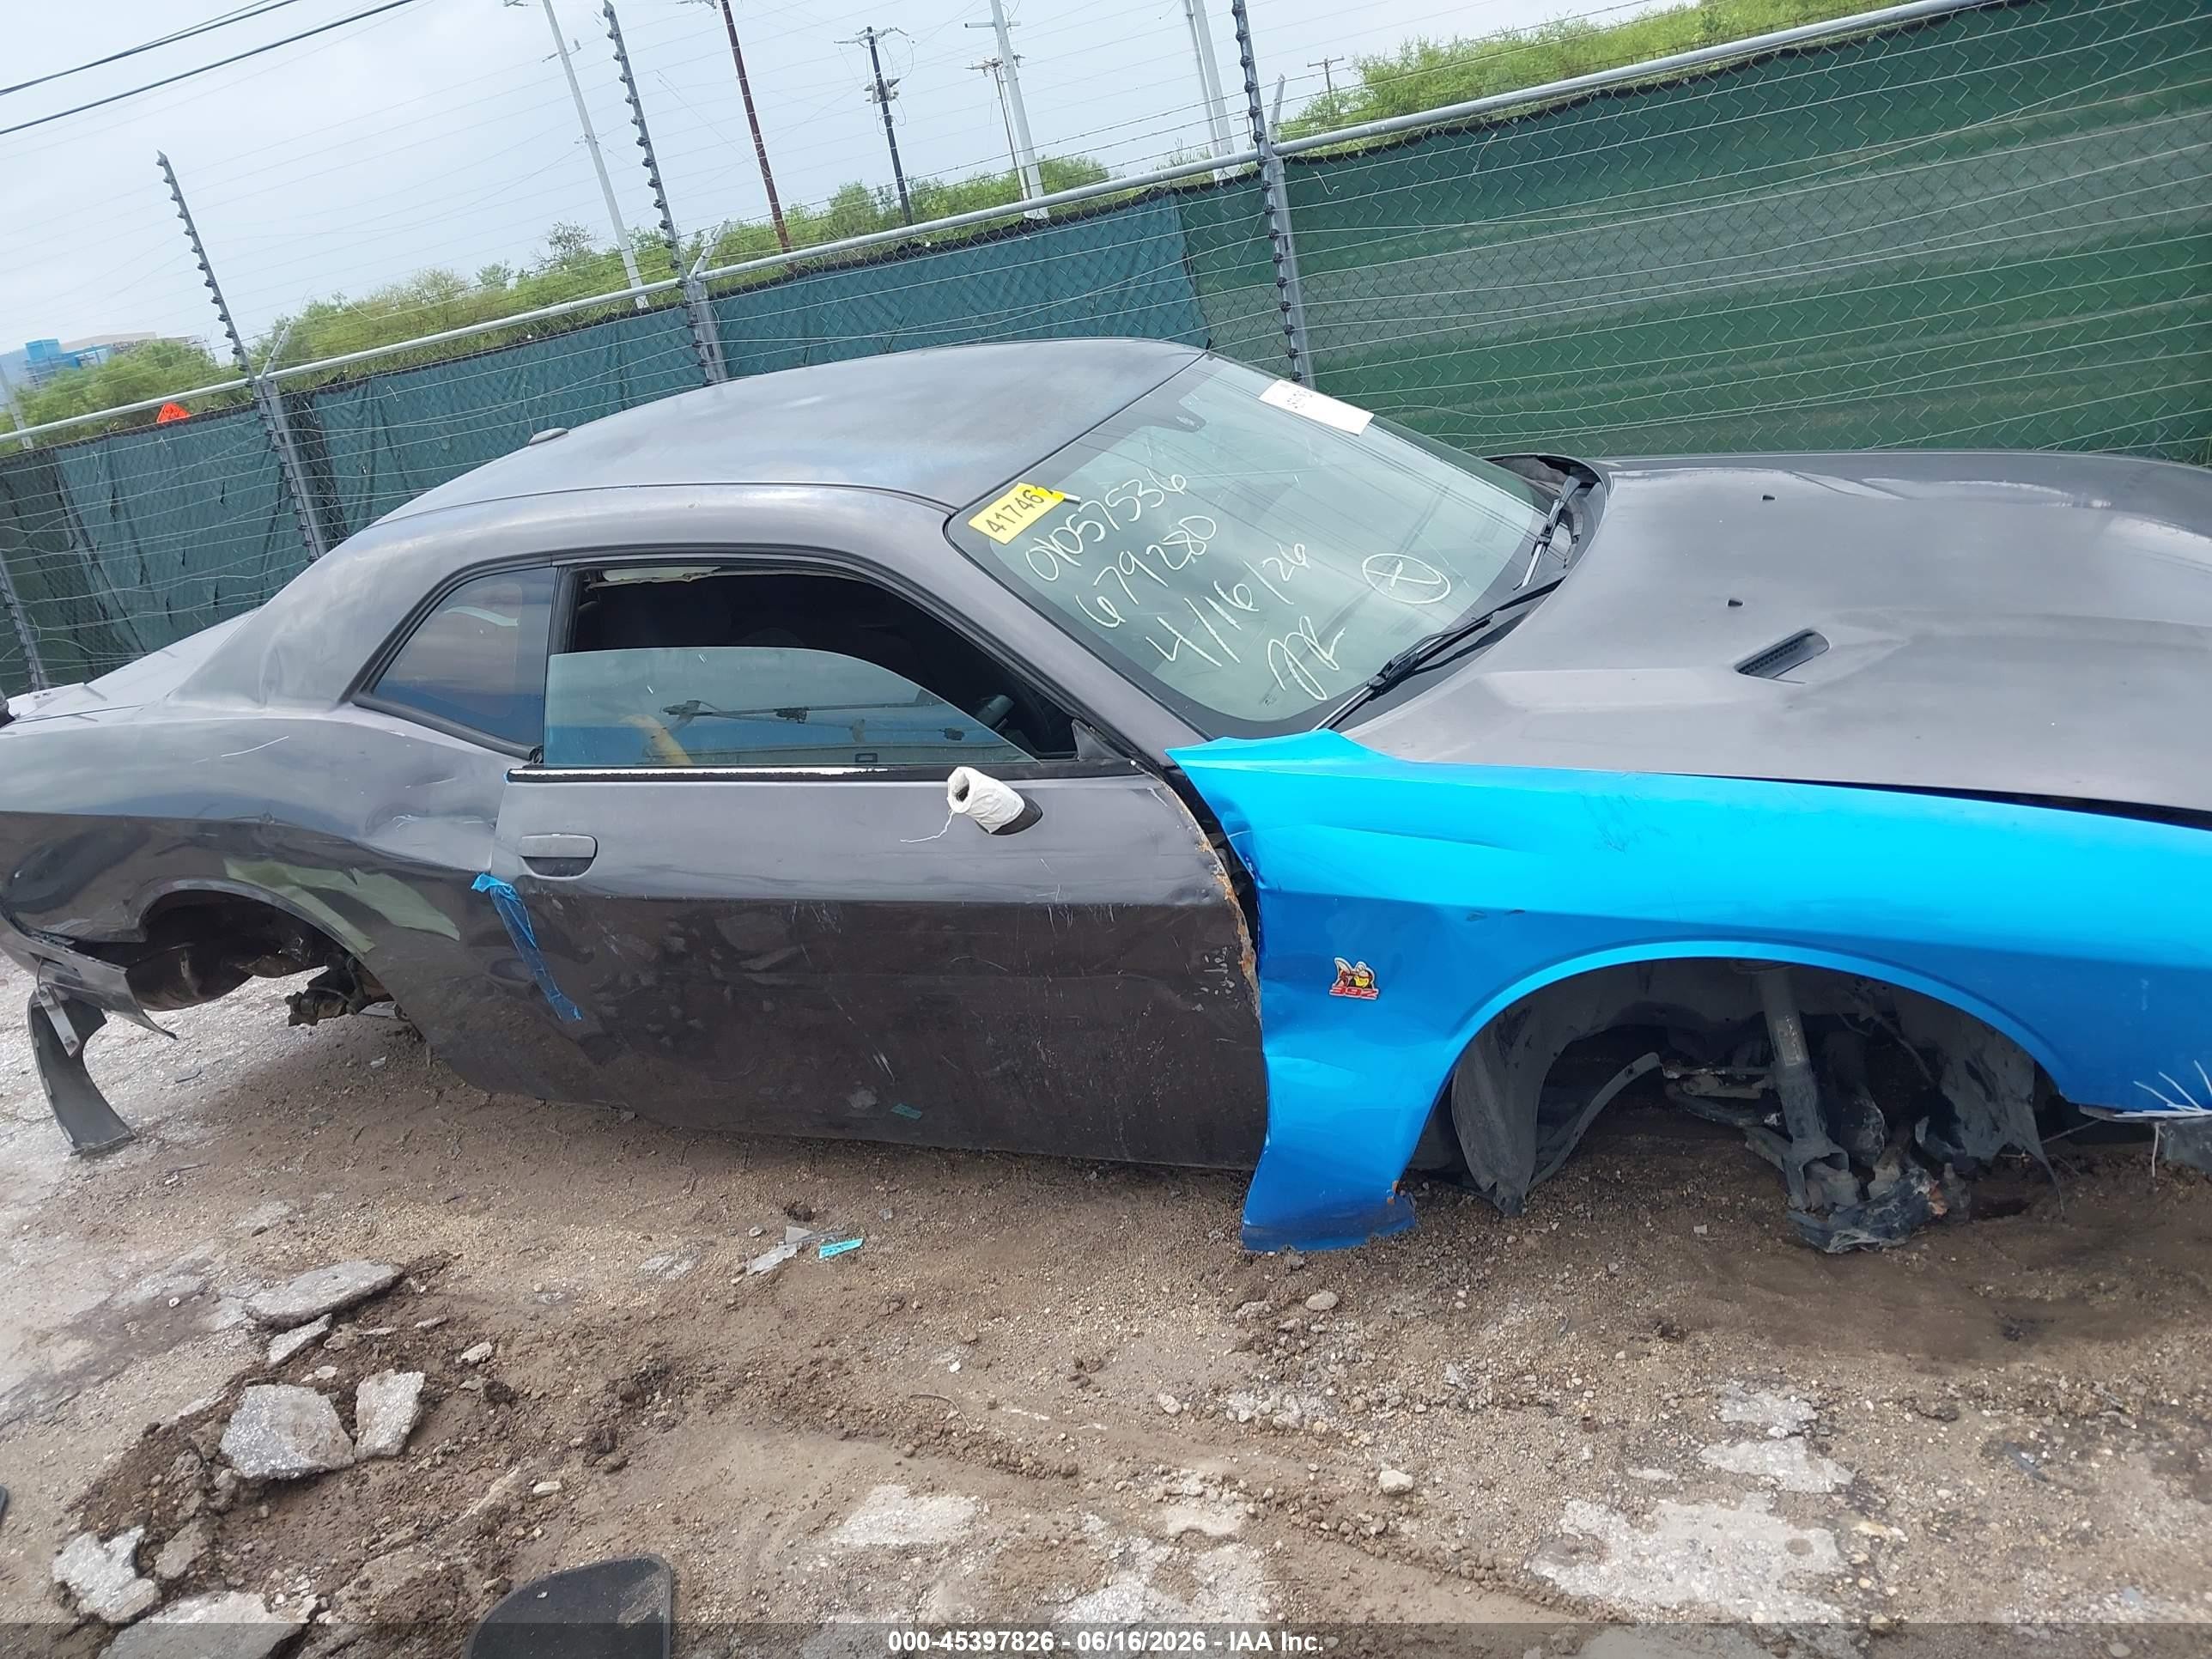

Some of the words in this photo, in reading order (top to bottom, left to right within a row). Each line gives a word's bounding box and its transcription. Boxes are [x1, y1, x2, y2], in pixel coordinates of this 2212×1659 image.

[1075, 514, 1217, 629] 679280
[1145, 543, 1310, 667] 4/16/26
[1329, 986, 1379, 1000] 392
